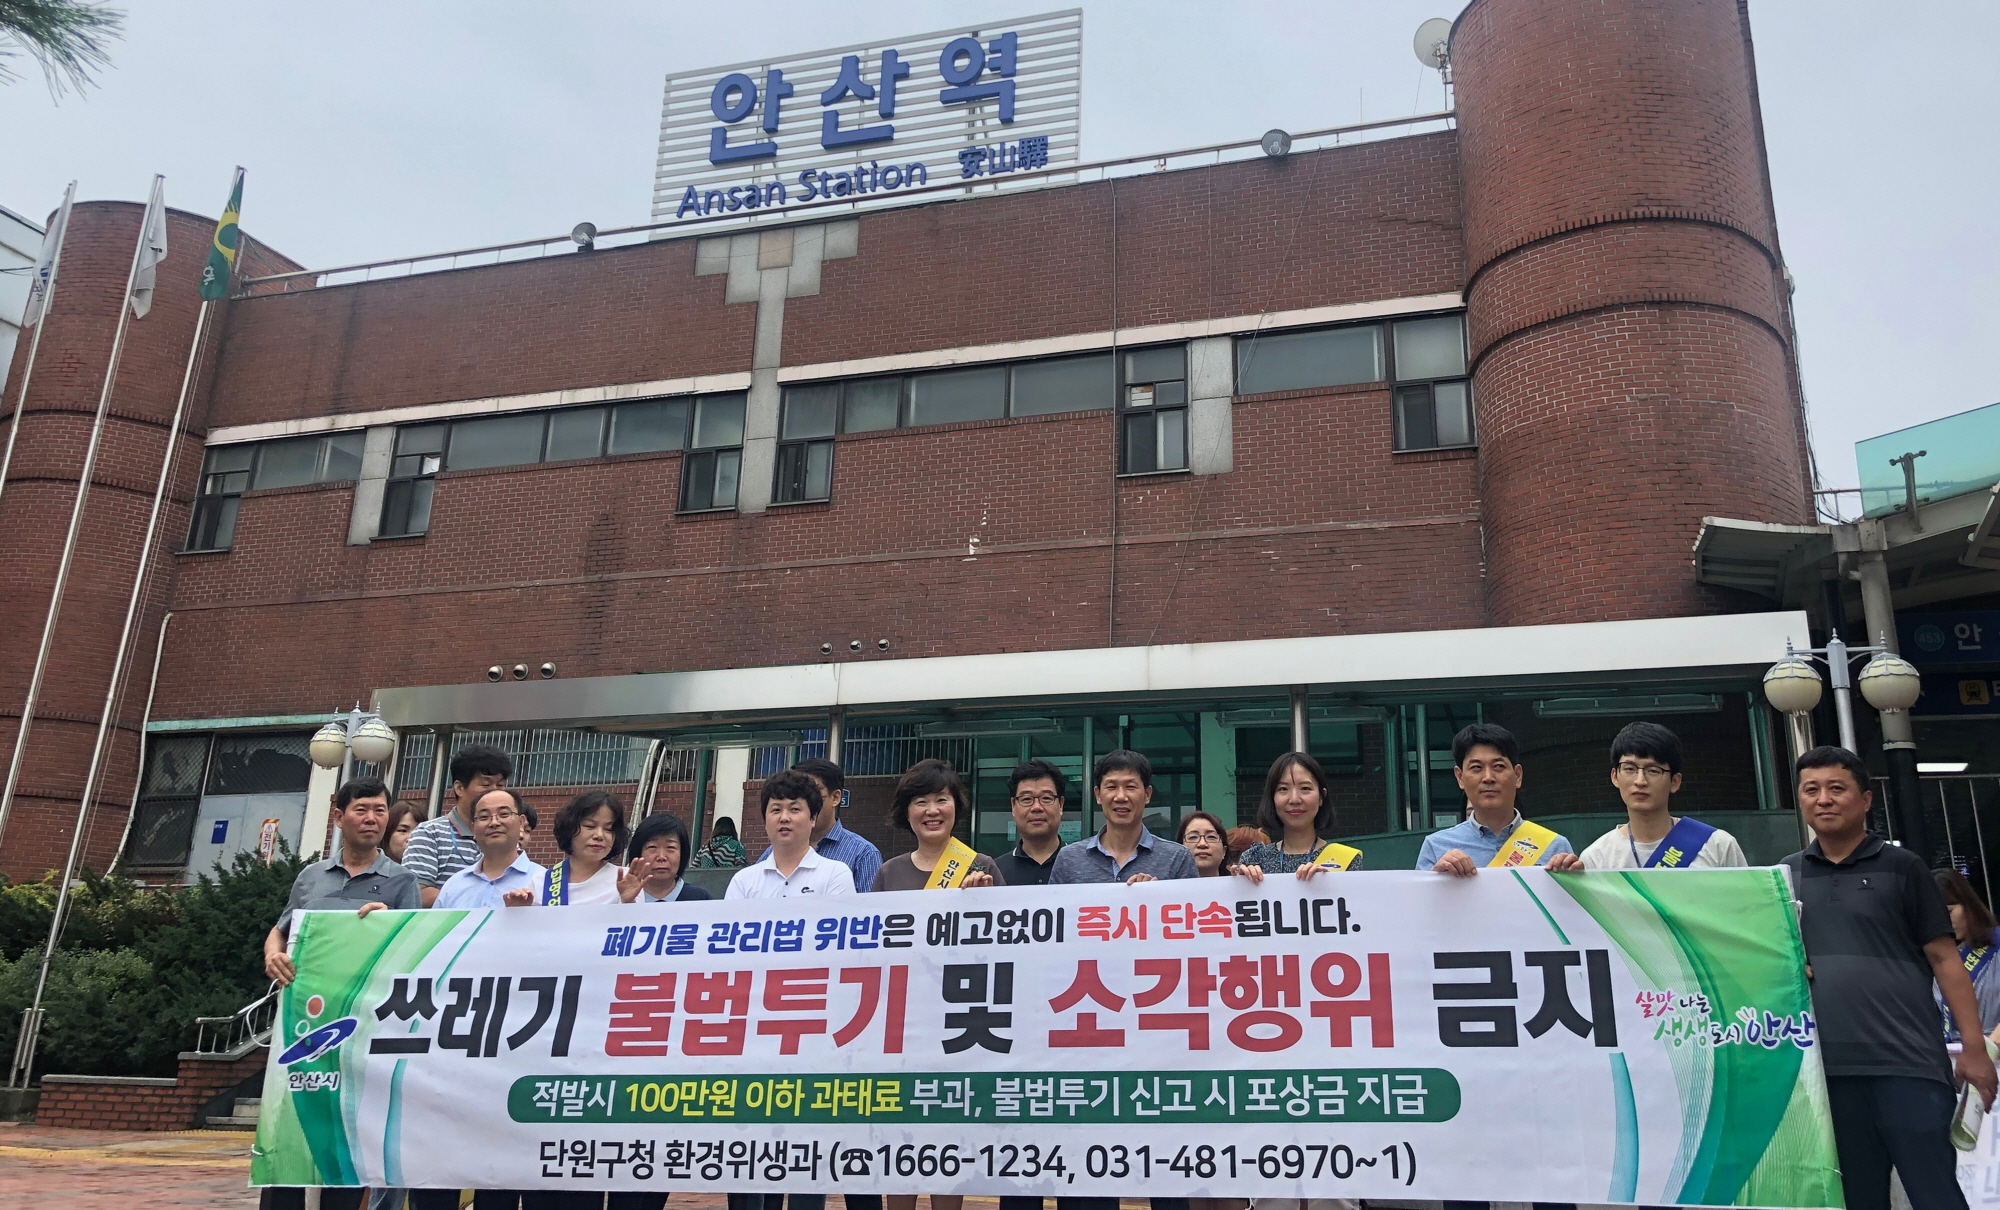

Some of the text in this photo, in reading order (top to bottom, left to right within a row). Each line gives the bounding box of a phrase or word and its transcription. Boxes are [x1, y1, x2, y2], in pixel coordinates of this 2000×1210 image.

[709, 31, 1018, 166] 안산역
[958, 135, 1049, 179] 安山驛
[676, 160, 927, 219] Ansan Station
[936, 859, 960, 889] 안산시
[601, 896, 1362, 957] 폐기물 관리법 위반은 예고없이 즉시 단속됩니다.
[368, 949, 1619, 1058] 쓰레기 불법투기 및 소각행위 금지
[1635, 990, 1710, 1018] 살맛 나는
[1746, 1010, 1816, 1048] 안산
[289, 1073, 339, 1089] 안산시
[531, 1074, 1428, 1119] 적발시 100만원 이하 과태료 부과, 불법투기 신고 시 포상금 지급
[539, 1139, 656, 1179] 단원구청
[664, 1139, 823, 1181] 환경위생과
[1085, 1140, 1418, 1187] 031-481-6970~1)
